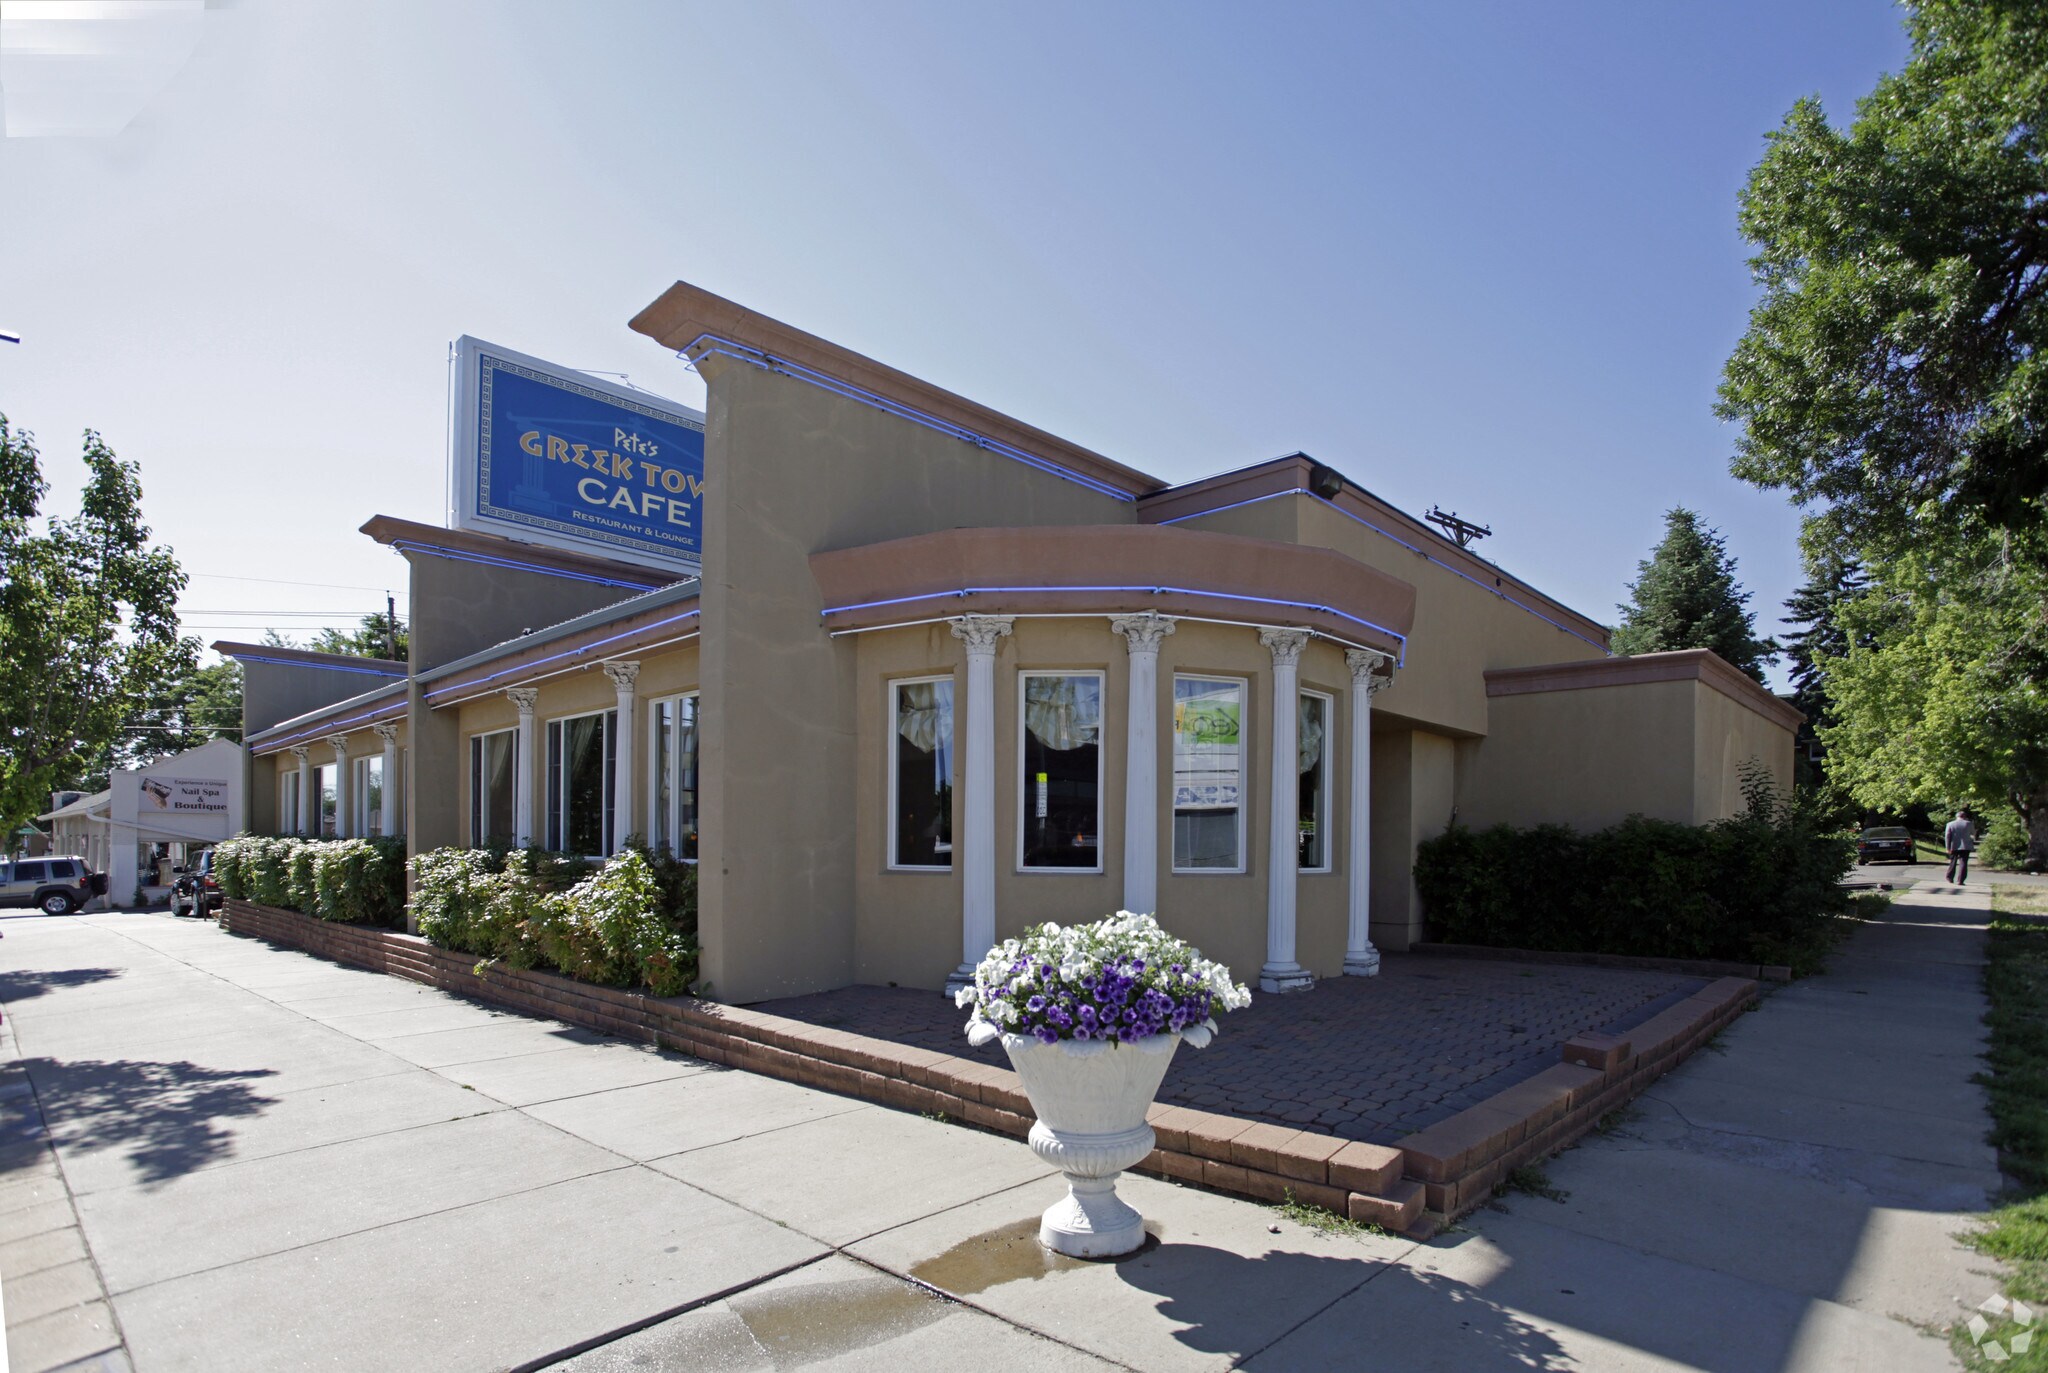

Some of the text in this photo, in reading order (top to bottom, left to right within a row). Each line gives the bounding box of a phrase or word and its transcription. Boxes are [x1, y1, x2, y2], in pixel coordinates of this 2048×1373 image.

[614, 427, 659, 457] Pete's
[519, 431, 634, 481] GREEK
[577, 477, 691, 528] CAFE
[644, 527, 653, 537] &
[202, 788, 219, 796] Spa
[174, 802, 227, 811] Boutique
